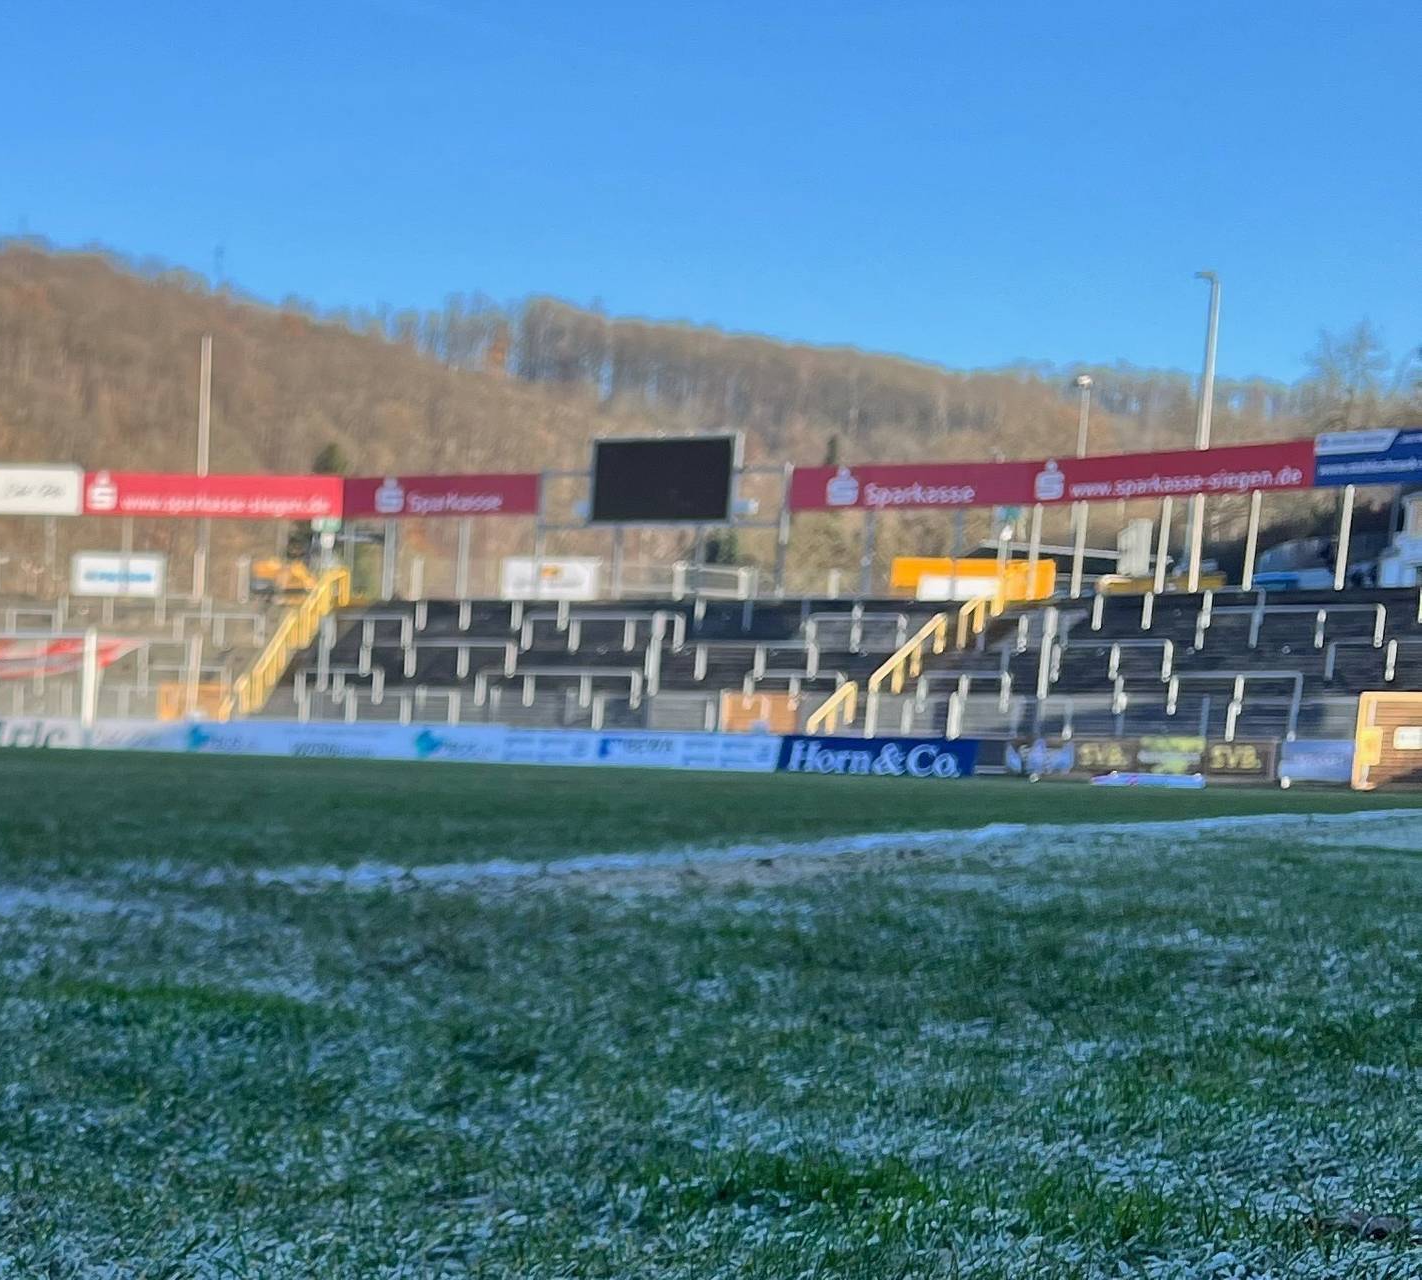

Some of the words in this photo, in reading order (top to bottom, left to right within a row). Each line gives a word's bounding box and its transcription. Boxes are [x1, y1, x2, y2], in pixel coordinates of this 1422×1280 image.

[864, 481, 976, 508] Sparkasse
[1070, 465, 1303, 497] www.sparkasse-siegen.de
[406, 490, 503, 515] Sparkasse
